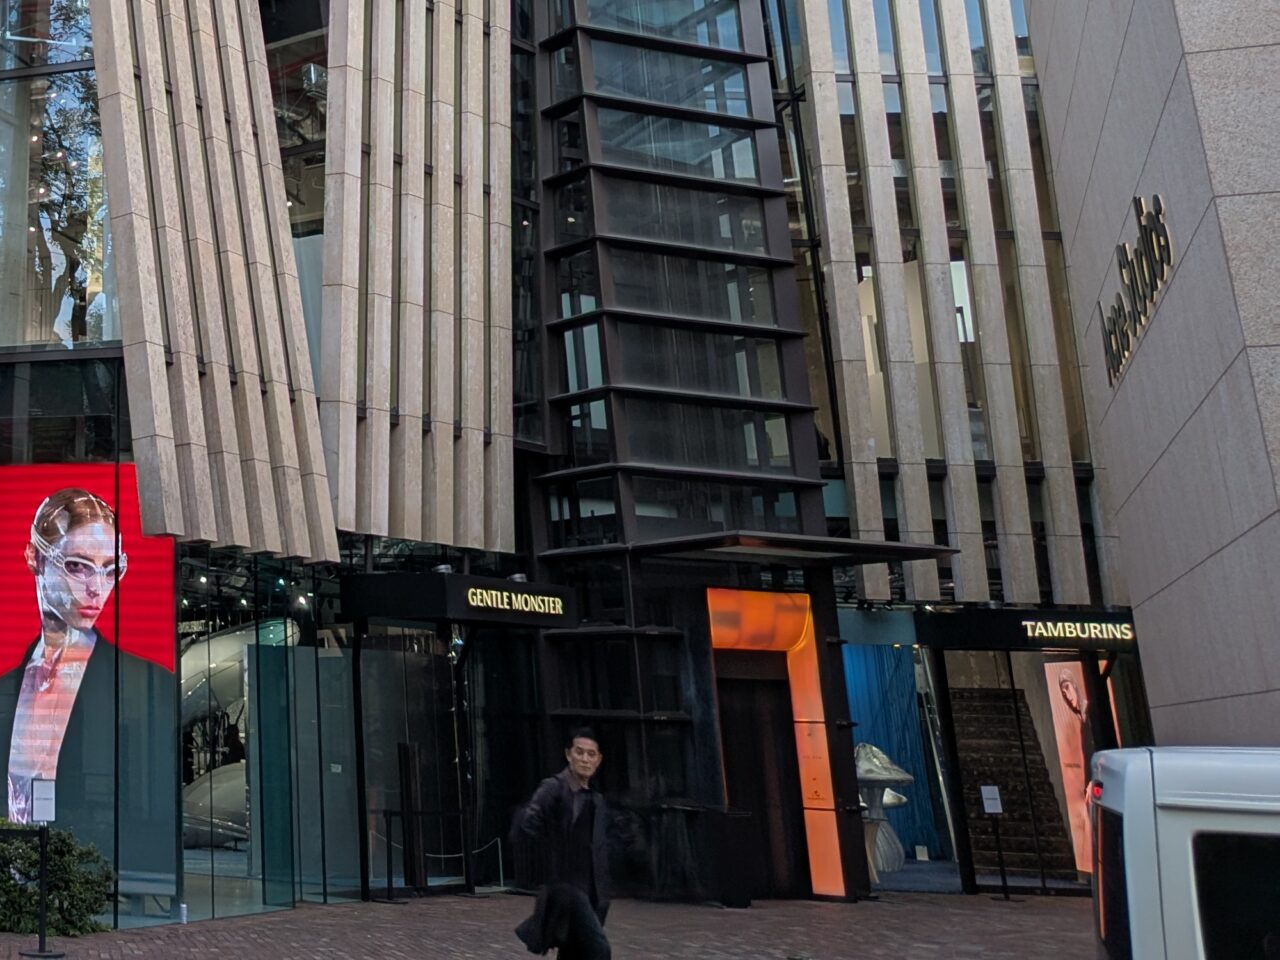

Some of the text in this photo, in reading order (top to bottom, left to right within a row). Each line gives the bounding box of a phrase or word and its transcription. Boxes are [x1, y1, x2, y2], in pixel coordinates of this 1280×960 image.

[1116, 194, 1173, 338] Studios
[467, 587, 563, 615] GENTLE MONSTER
[1021, 620, 1134, 640] TAMBURINS
